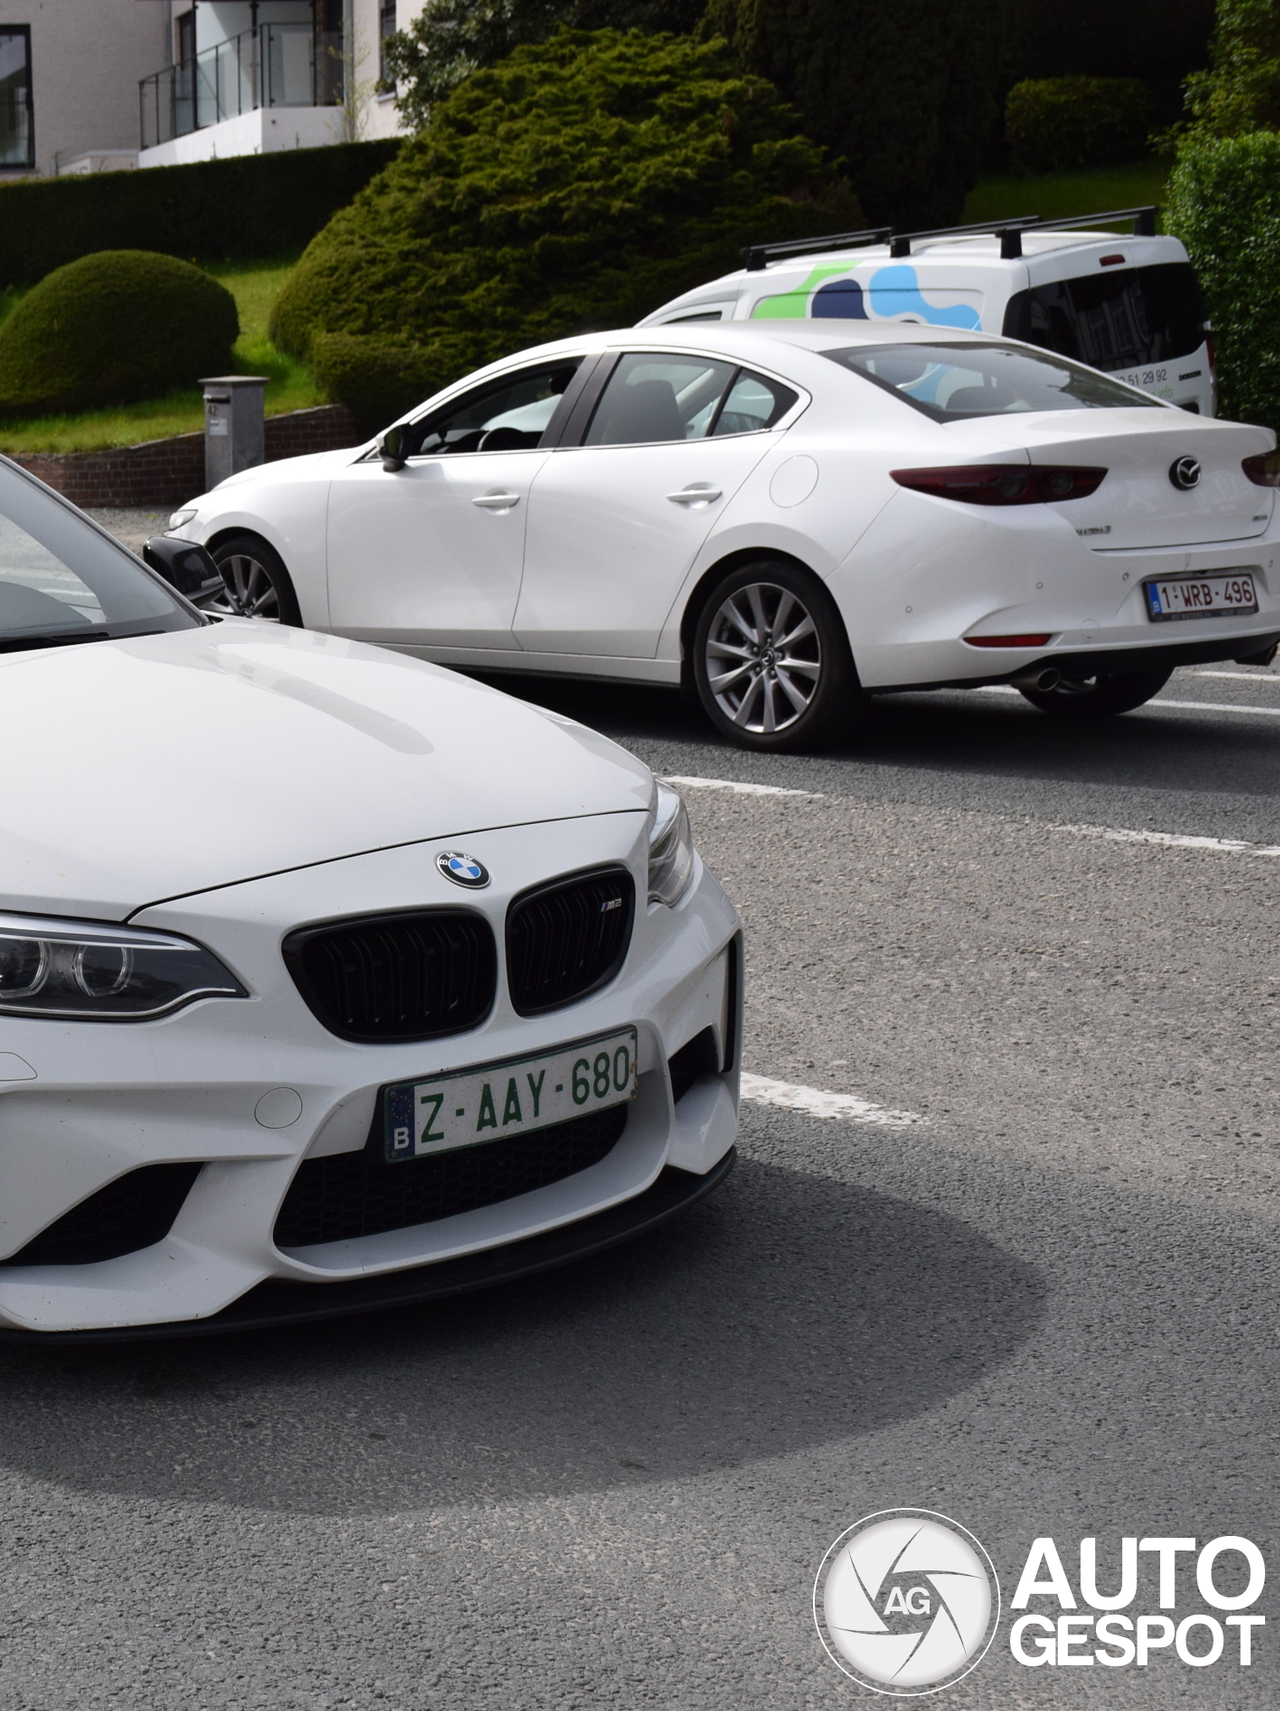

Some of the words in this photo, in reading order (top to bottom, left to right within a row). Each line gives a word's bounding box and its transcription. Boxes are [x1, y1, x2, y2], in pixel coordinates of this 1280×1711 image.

[1142, 371, 1155, 384] 29
[1156, 368, 1168, 382] 92
[208, 405, 217, 416] 42
[601, 898, 622, 912] M2
[394, 1127, 410, 1150] B
